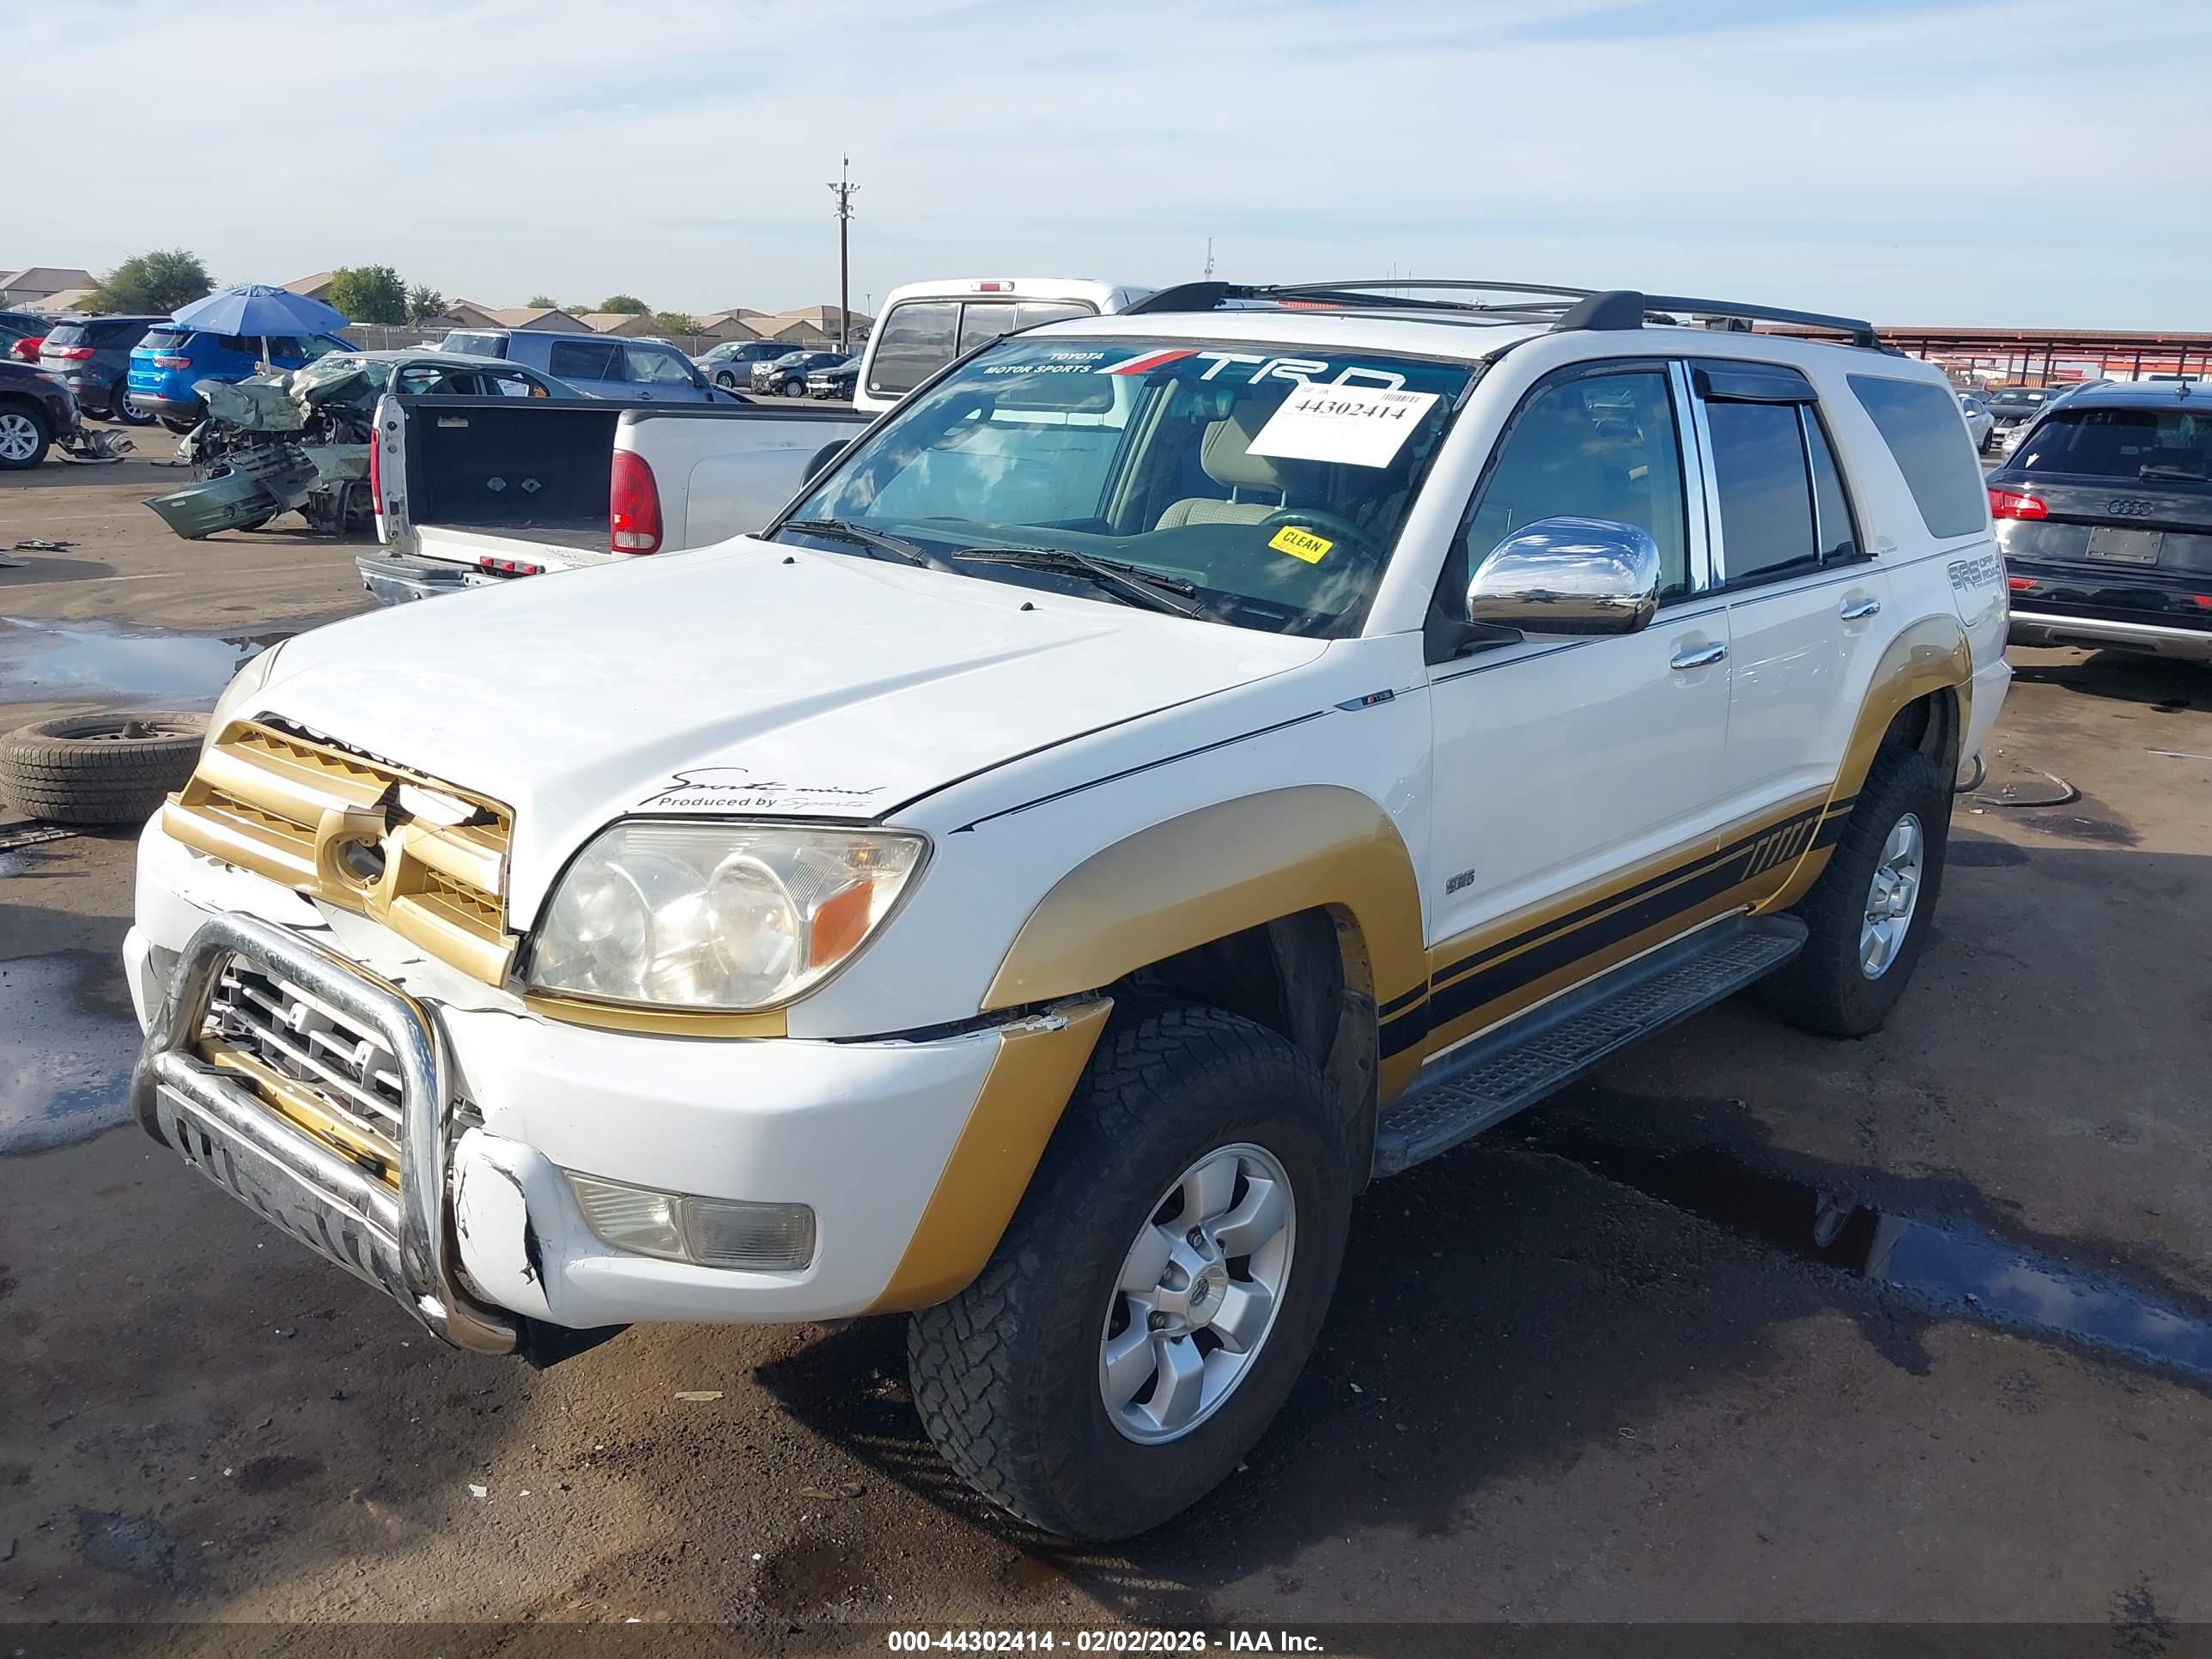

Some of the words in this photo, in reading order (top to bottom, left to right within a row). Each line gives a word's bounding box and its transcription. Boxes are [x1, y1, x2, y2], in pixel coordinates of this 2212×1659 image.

[1049, 352, 1105, 361] TOYOTA
[983, 365, 1034, 374] MOTOR
[1034, 365, 1092, 374] SPORTS
[1196, 352, 1407, 391] TRD
[1295, 399, 1407, 420] 44302414
[1283, 531, 1323, 552] CLEAN
[658, 796, 750, 807] Produced
[755, 795, 778, 807] by
